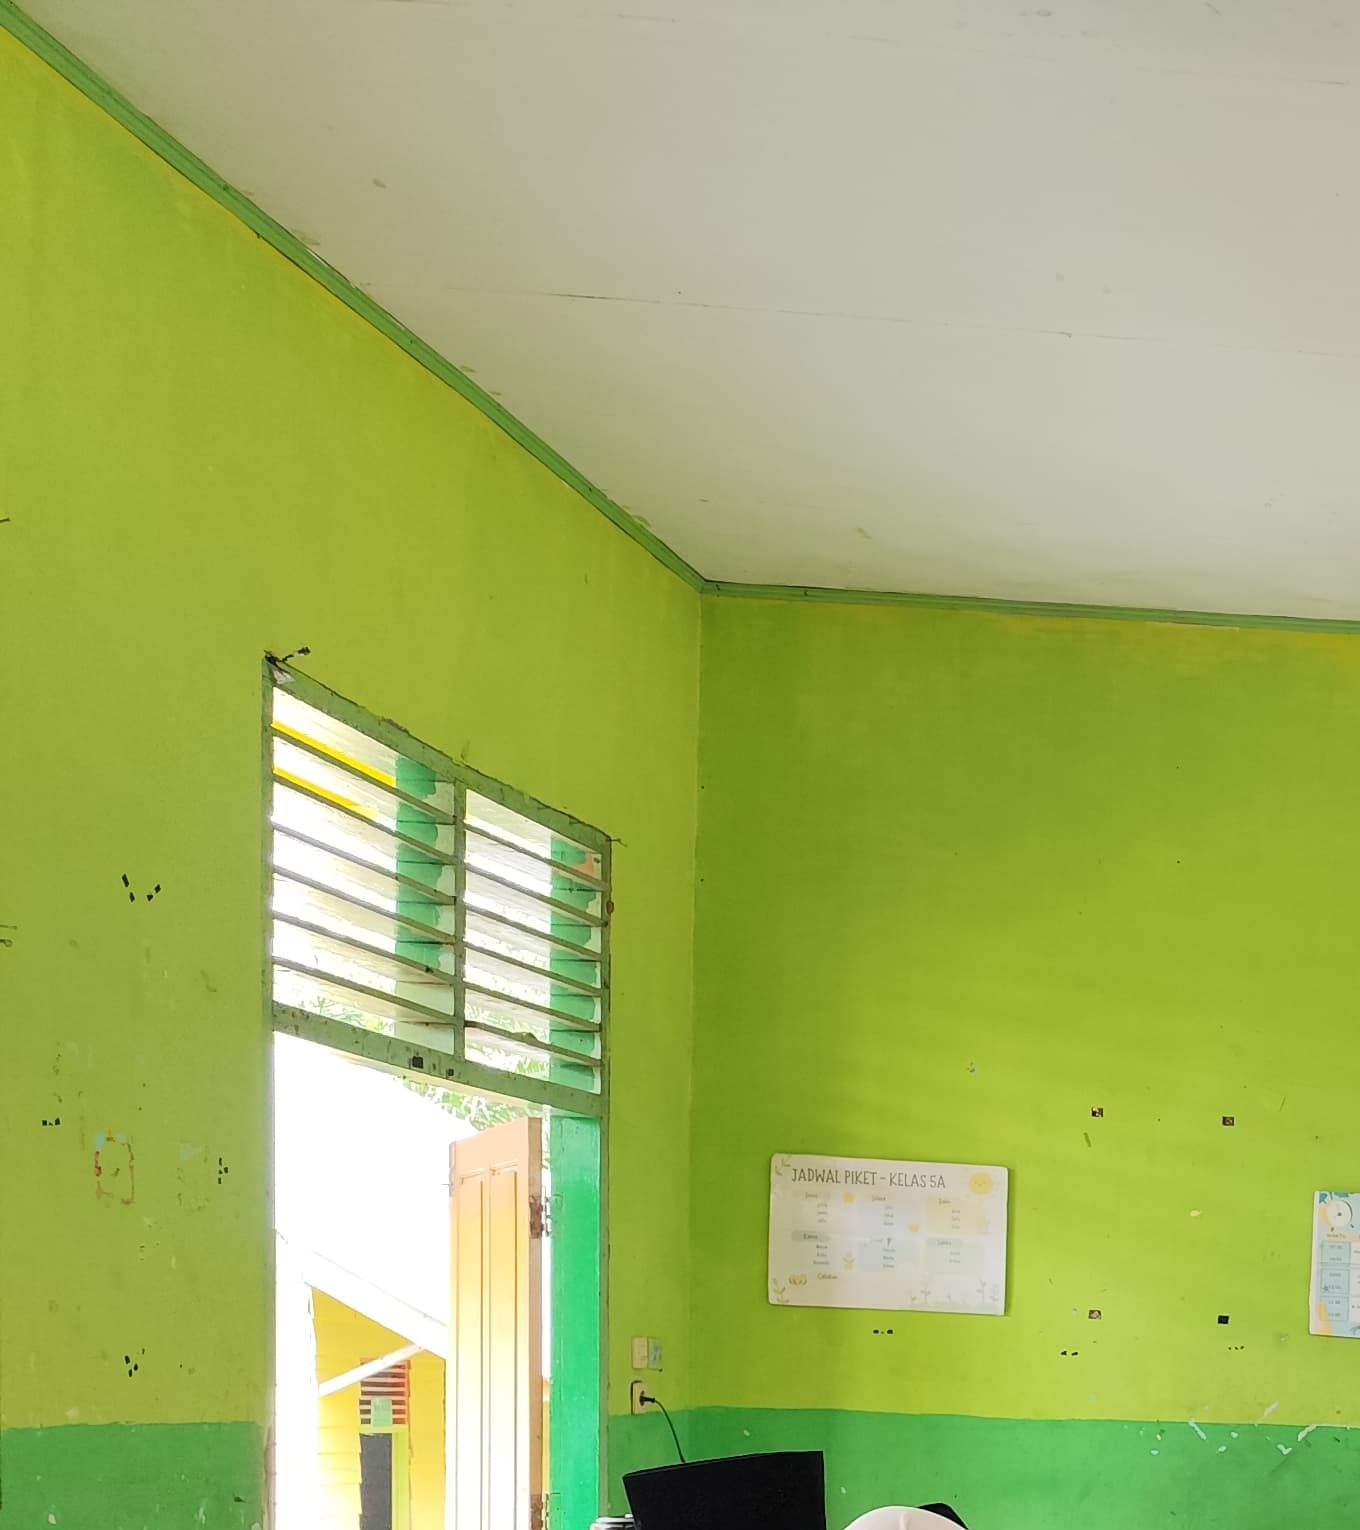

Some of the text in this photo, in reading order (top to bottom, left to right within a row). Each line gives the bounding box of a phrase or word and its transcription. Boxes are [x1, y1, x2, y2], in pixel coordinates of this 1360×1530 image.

[791, 1168, 841, 1184] JADWAL
[844, 1170, 878, 1187] PIKET
[889, 1173, 927, 1188] KELAS
[930, 1175, 946, 1189] 5A
